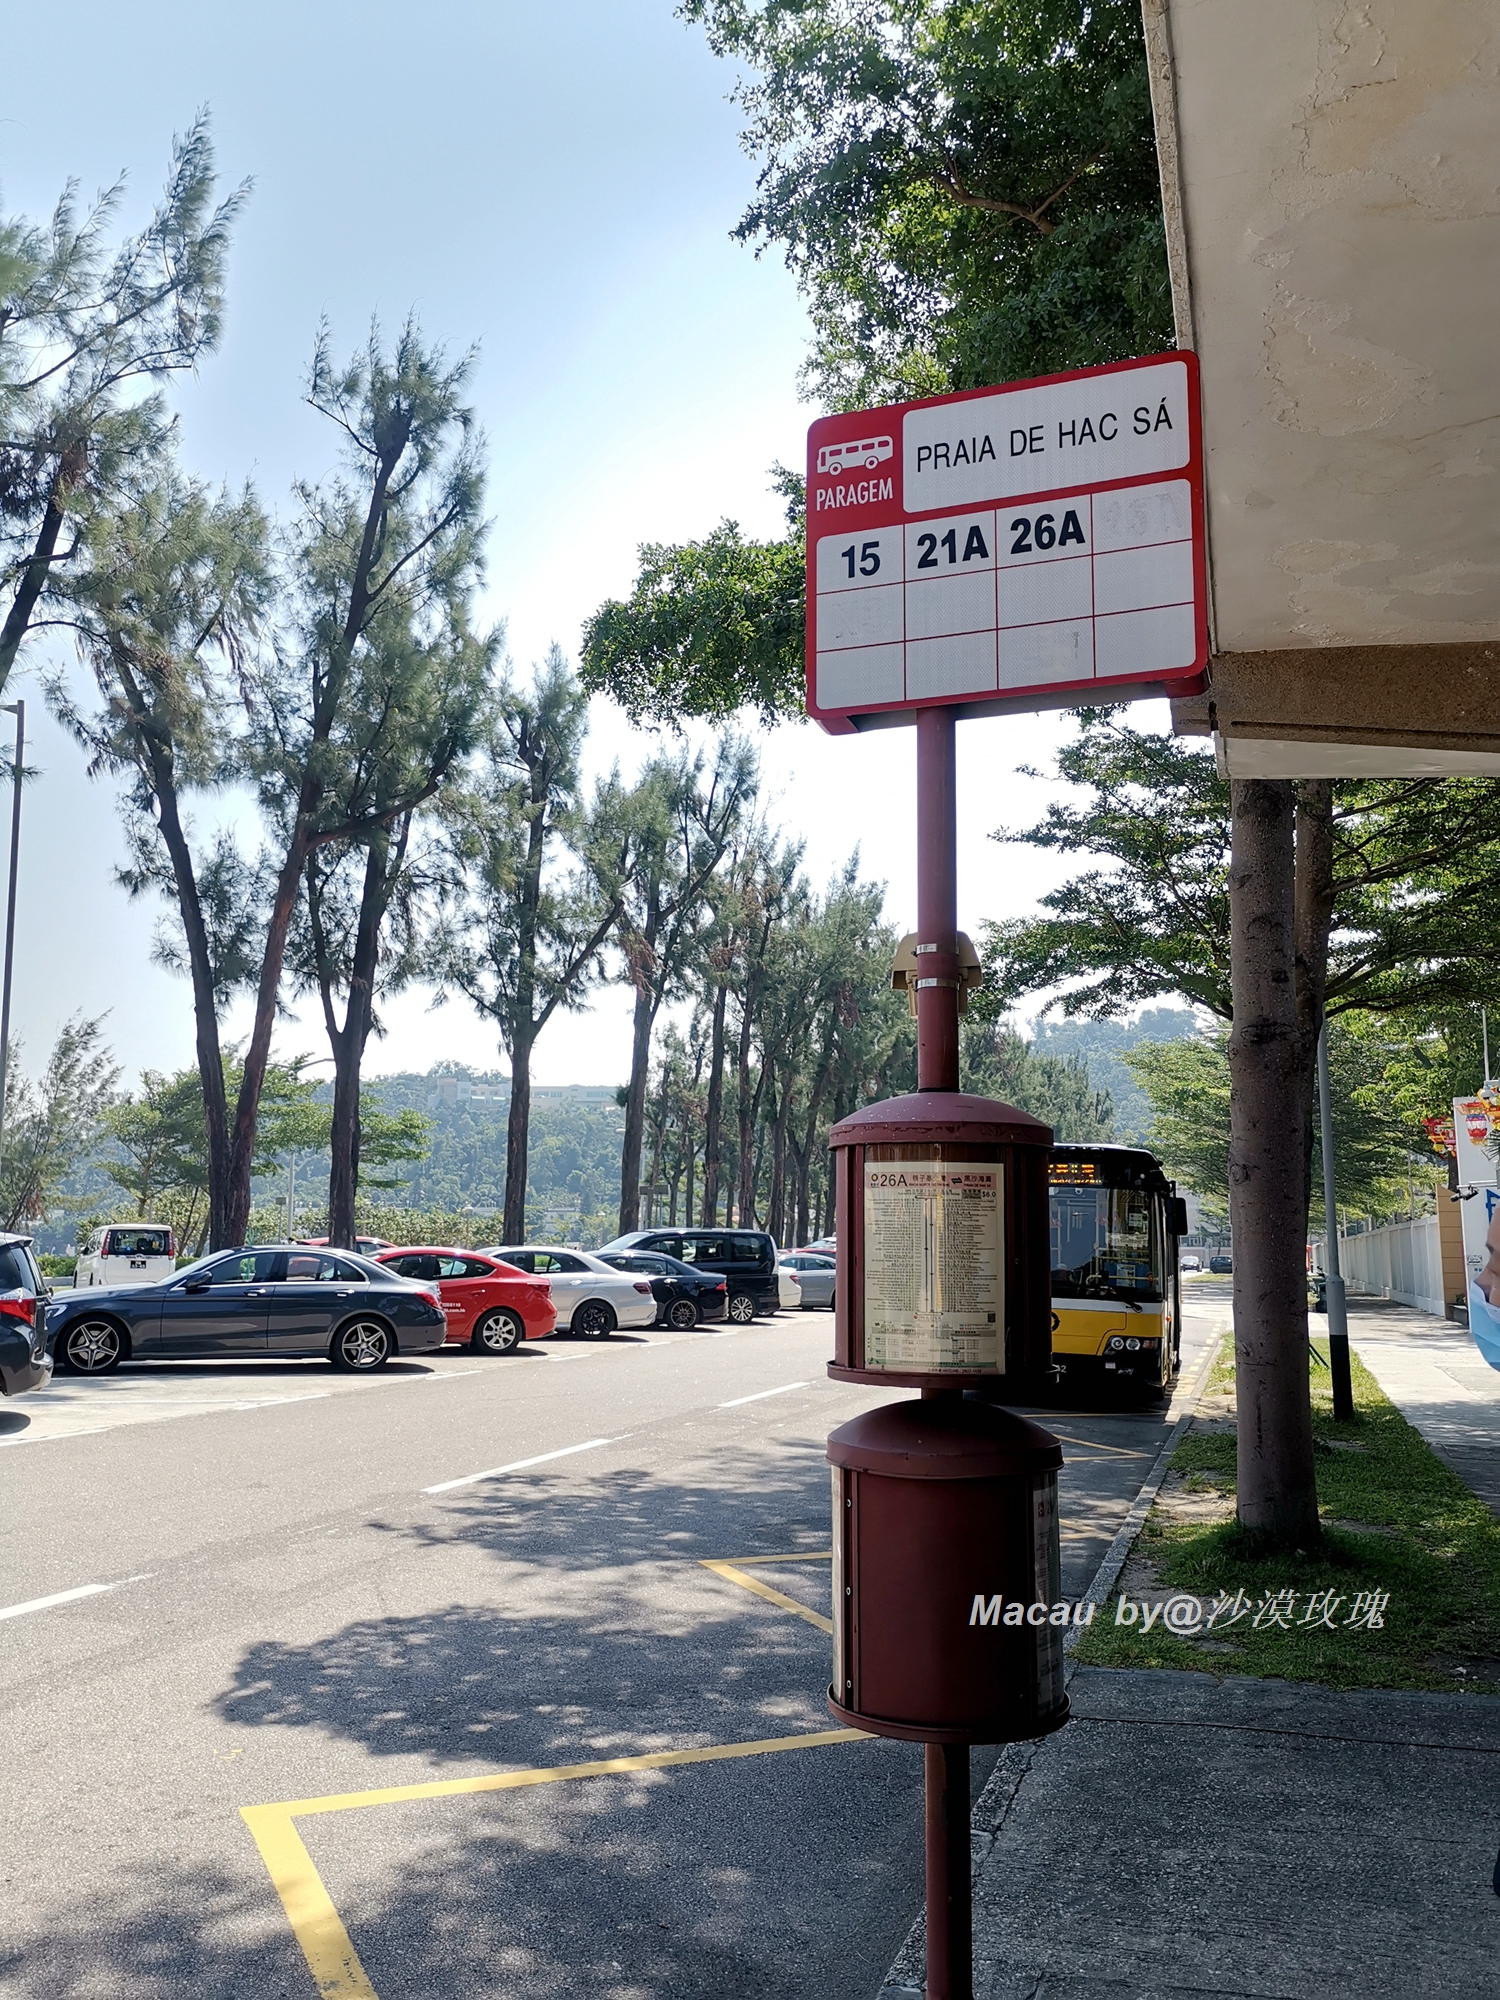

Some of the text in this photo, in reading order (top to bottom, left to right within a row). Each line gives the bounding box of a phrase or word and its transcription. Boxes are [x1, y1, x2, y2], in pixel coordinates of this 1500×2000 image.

[916, 396, 1173, 473] PRAIA DE HAC SÁ
[816, 477, 894, 512] PARAGEM
[841, 509, 1086, 579] 15 21A 26A
[880, 1174, 908, 1187] 26A
